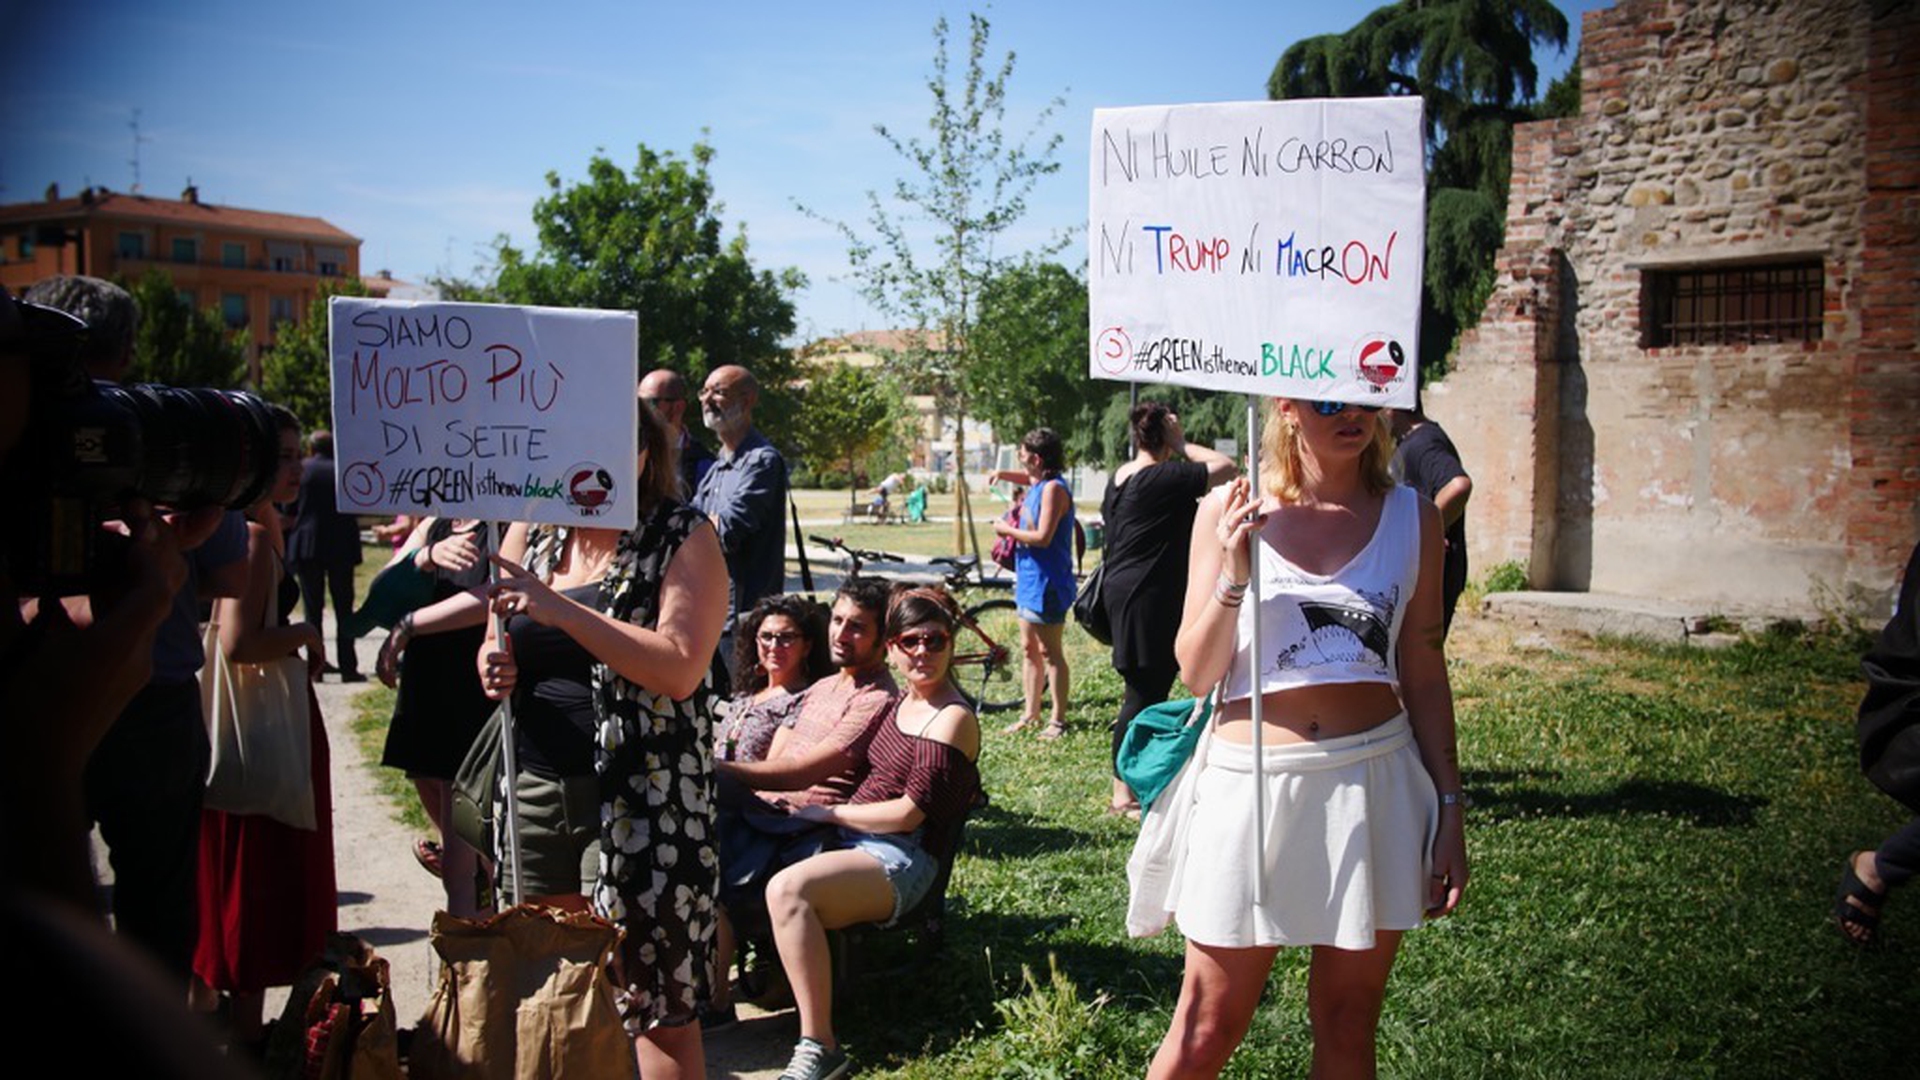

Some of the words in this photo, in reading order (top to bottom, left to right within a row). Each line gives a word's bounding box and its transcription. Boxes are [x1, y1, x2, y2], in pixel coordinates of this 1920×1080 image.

[1103, 127, 1139, 186] NI
[1152, 131, 1228, 179] HUILE
[1242, 126, 1267, 177] NI
[1276, 130, 1394, 174] CARBON
[1101, 219, 1133, 277] NI
[1142, 226, 1230, 275] TRUMP
[1241, 222, 1262, 275] NI
[1276, 230, 1398, 285] MACRON
[352, 311, 472, 349] SIAMO
[351, 350, 467, 415] MOLTO
[484, 344, 564, 411] PIÙ
[380, 419, 422, 456] DI
[445, 419, 549, 461] SETTE
